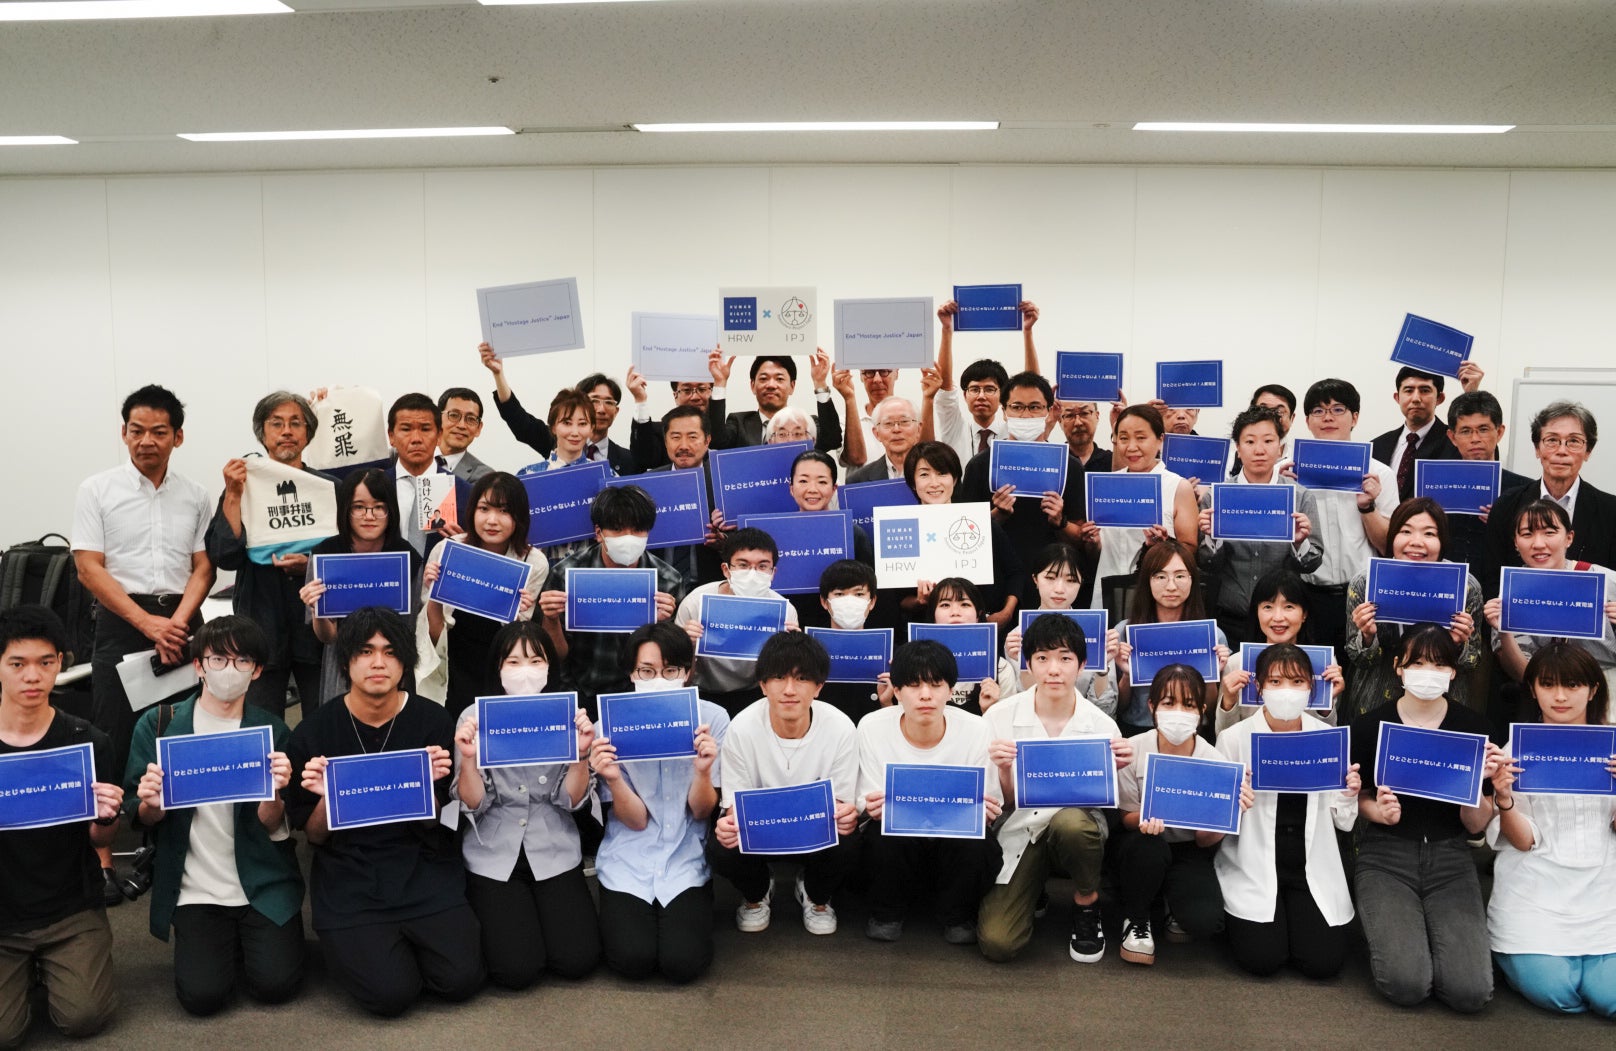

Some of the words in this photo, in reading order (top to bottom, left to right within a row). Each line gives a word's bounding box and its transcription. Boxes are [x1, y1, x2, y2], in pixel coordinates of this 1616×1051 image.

[727, 334, 754, 342] HRW
[785, 333, 805, 342] IPJ
[331, 408, 358, 458] 無罪
[724, 476, 792, 491] ひとごとじゃないよ！人
[267, 501, 312, 517] 刑事弁護
[528, 496, 596, 516] とごとじゃないよ！人質
[655, 502, 698, 514] いよ！人質司法
[268, 513, 316, 530] OASIS
[778, 547, 843, 558] じゃないよ！人質司法
[885, 561, 917, 572] HRW
[954, 559, 977, 569] IPJ
[0, 780, 82, 798] ごとじゃないよ！人質司法
